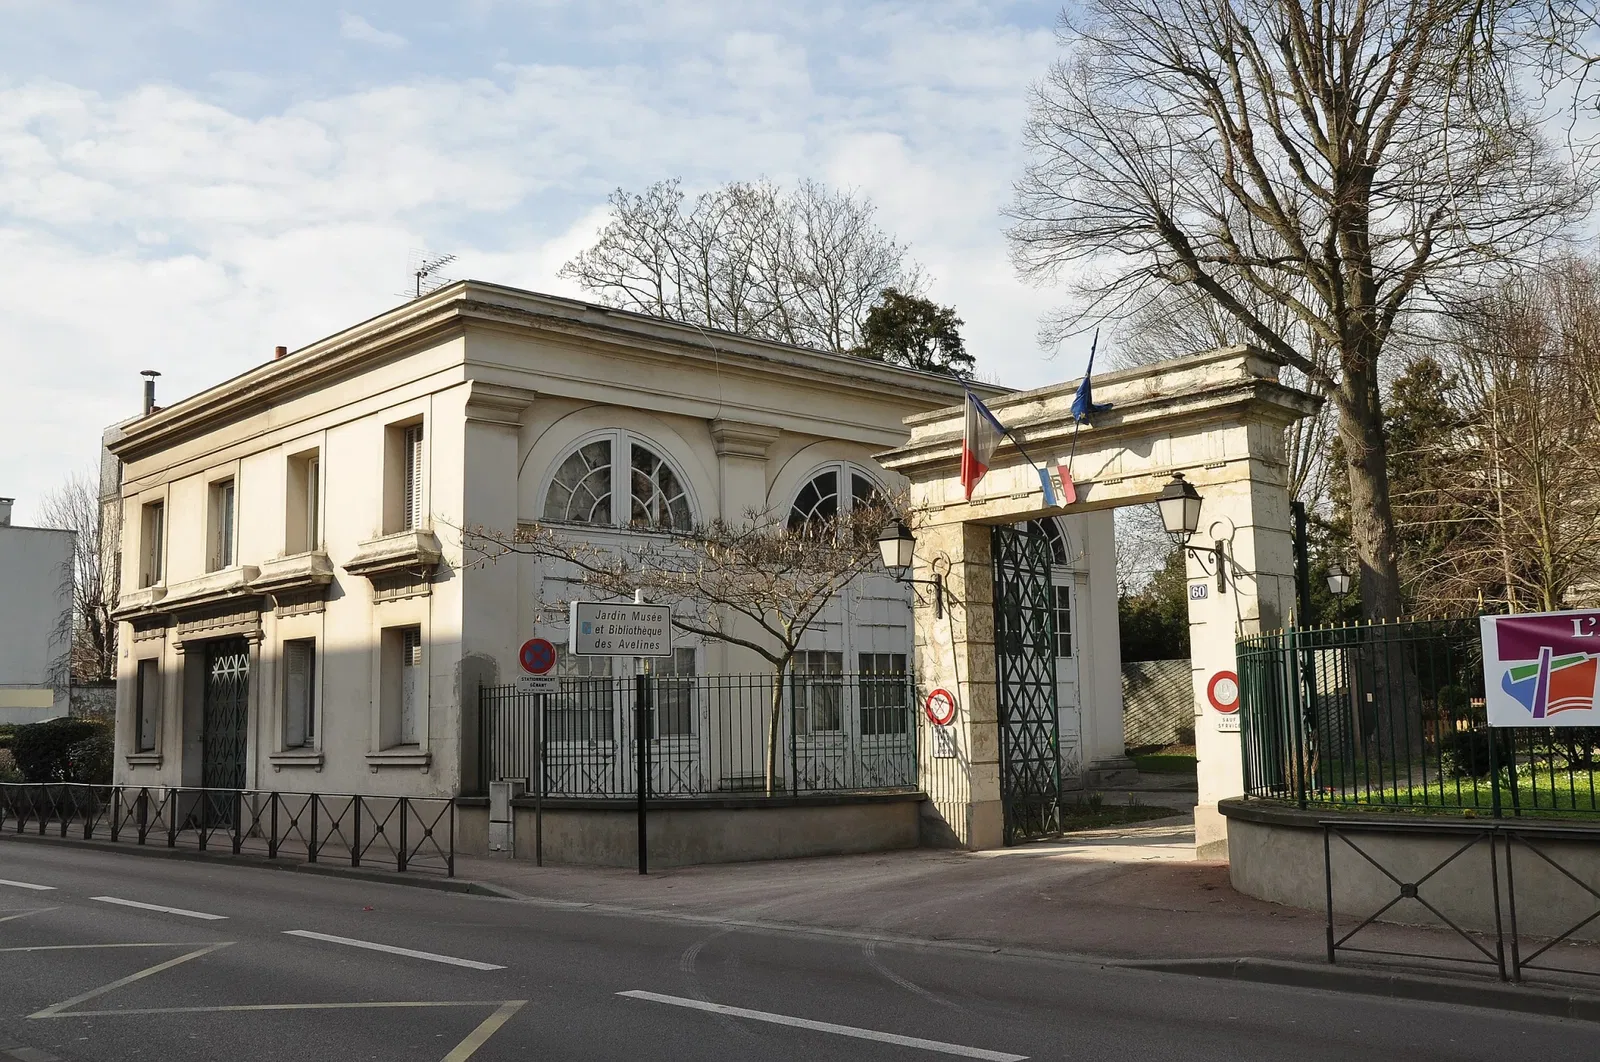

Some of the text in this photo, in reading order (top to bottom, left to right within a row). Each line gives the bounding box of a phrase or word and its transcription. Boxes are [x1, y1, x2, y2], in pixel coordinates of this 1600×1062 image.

[1192, 586, 1205, 598] 60
[595, 610, 662, 622] Jardin Musée
[595, 624, 662, 637] et Bibliothèque
[1570, 617, 1600, 638] L'
[594, 638, 660, 650] des Avelines
